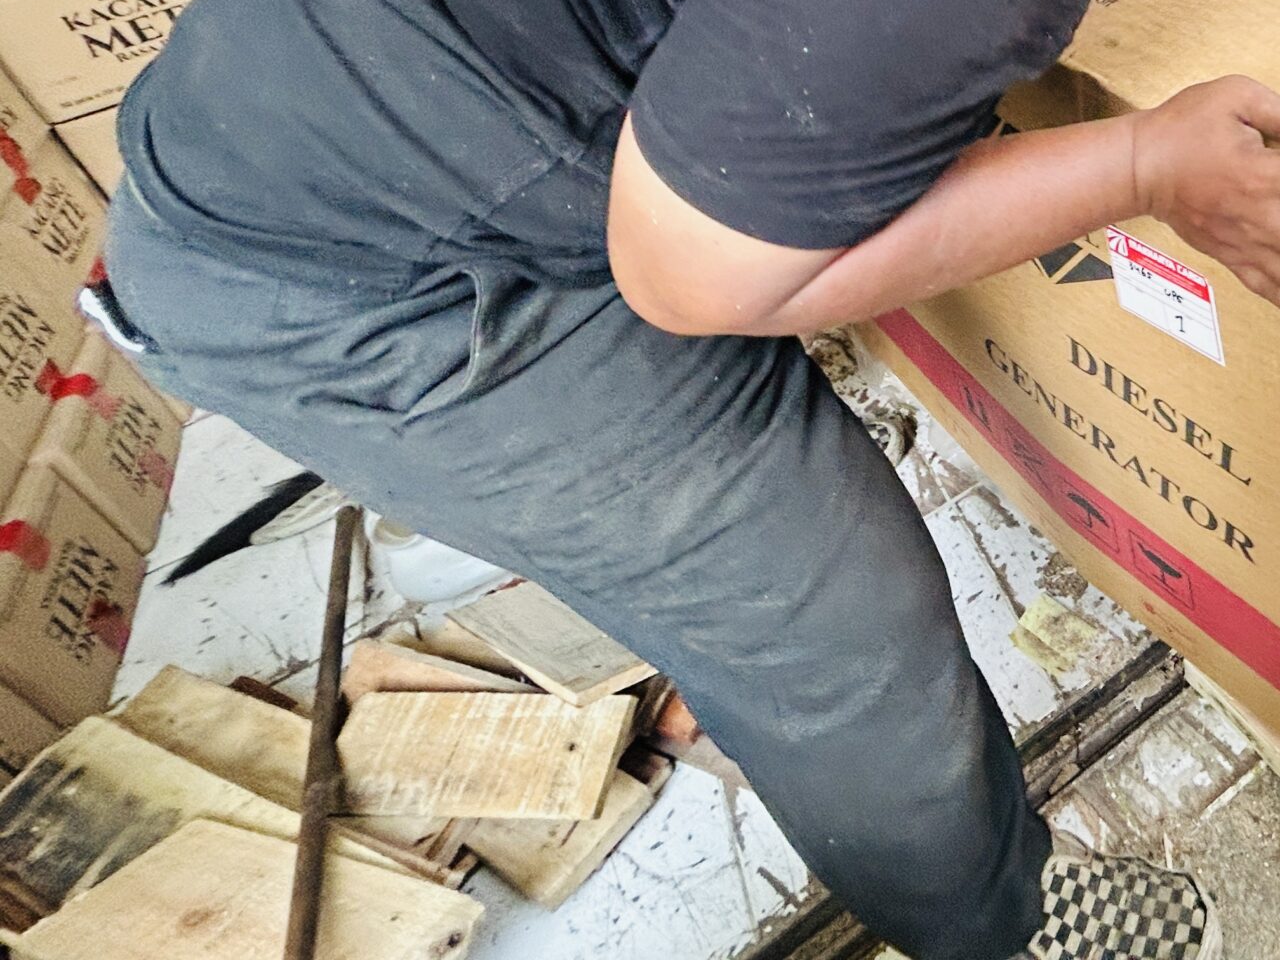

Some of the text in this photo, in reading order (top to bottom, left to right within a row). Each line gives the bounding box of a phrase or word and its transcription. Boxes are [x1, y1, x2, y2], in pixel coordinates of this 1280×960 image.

[110, 395, 147, 477] METE
[983, 337, 1256, 565] GENERATOR
[1065, 333, 1252, 488] DIESEL
[50, 536, 100, 640] METE
